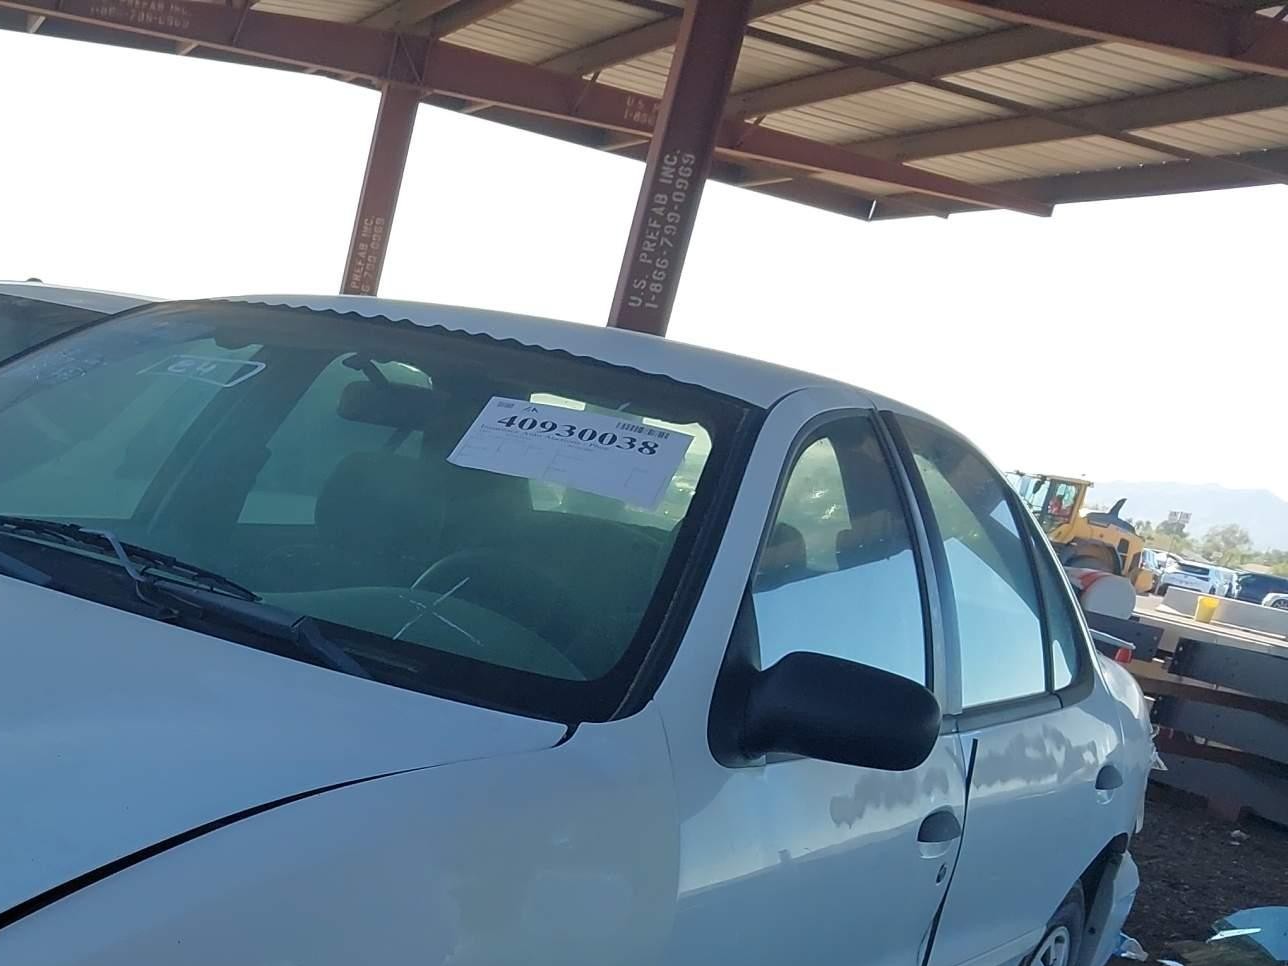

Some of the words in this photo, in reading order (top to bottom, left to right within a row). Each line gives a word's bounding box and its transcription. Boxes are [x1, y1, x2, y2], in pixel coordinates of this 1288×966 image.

[628, 274, 649, 308] U.S.
[639, 193, 669, 265] PREFAB
[659, 149, 681, 185] INC.
[645, 153, 696, 309] 1-866-799-0969
[497, 415, 660, 456] 40930038
